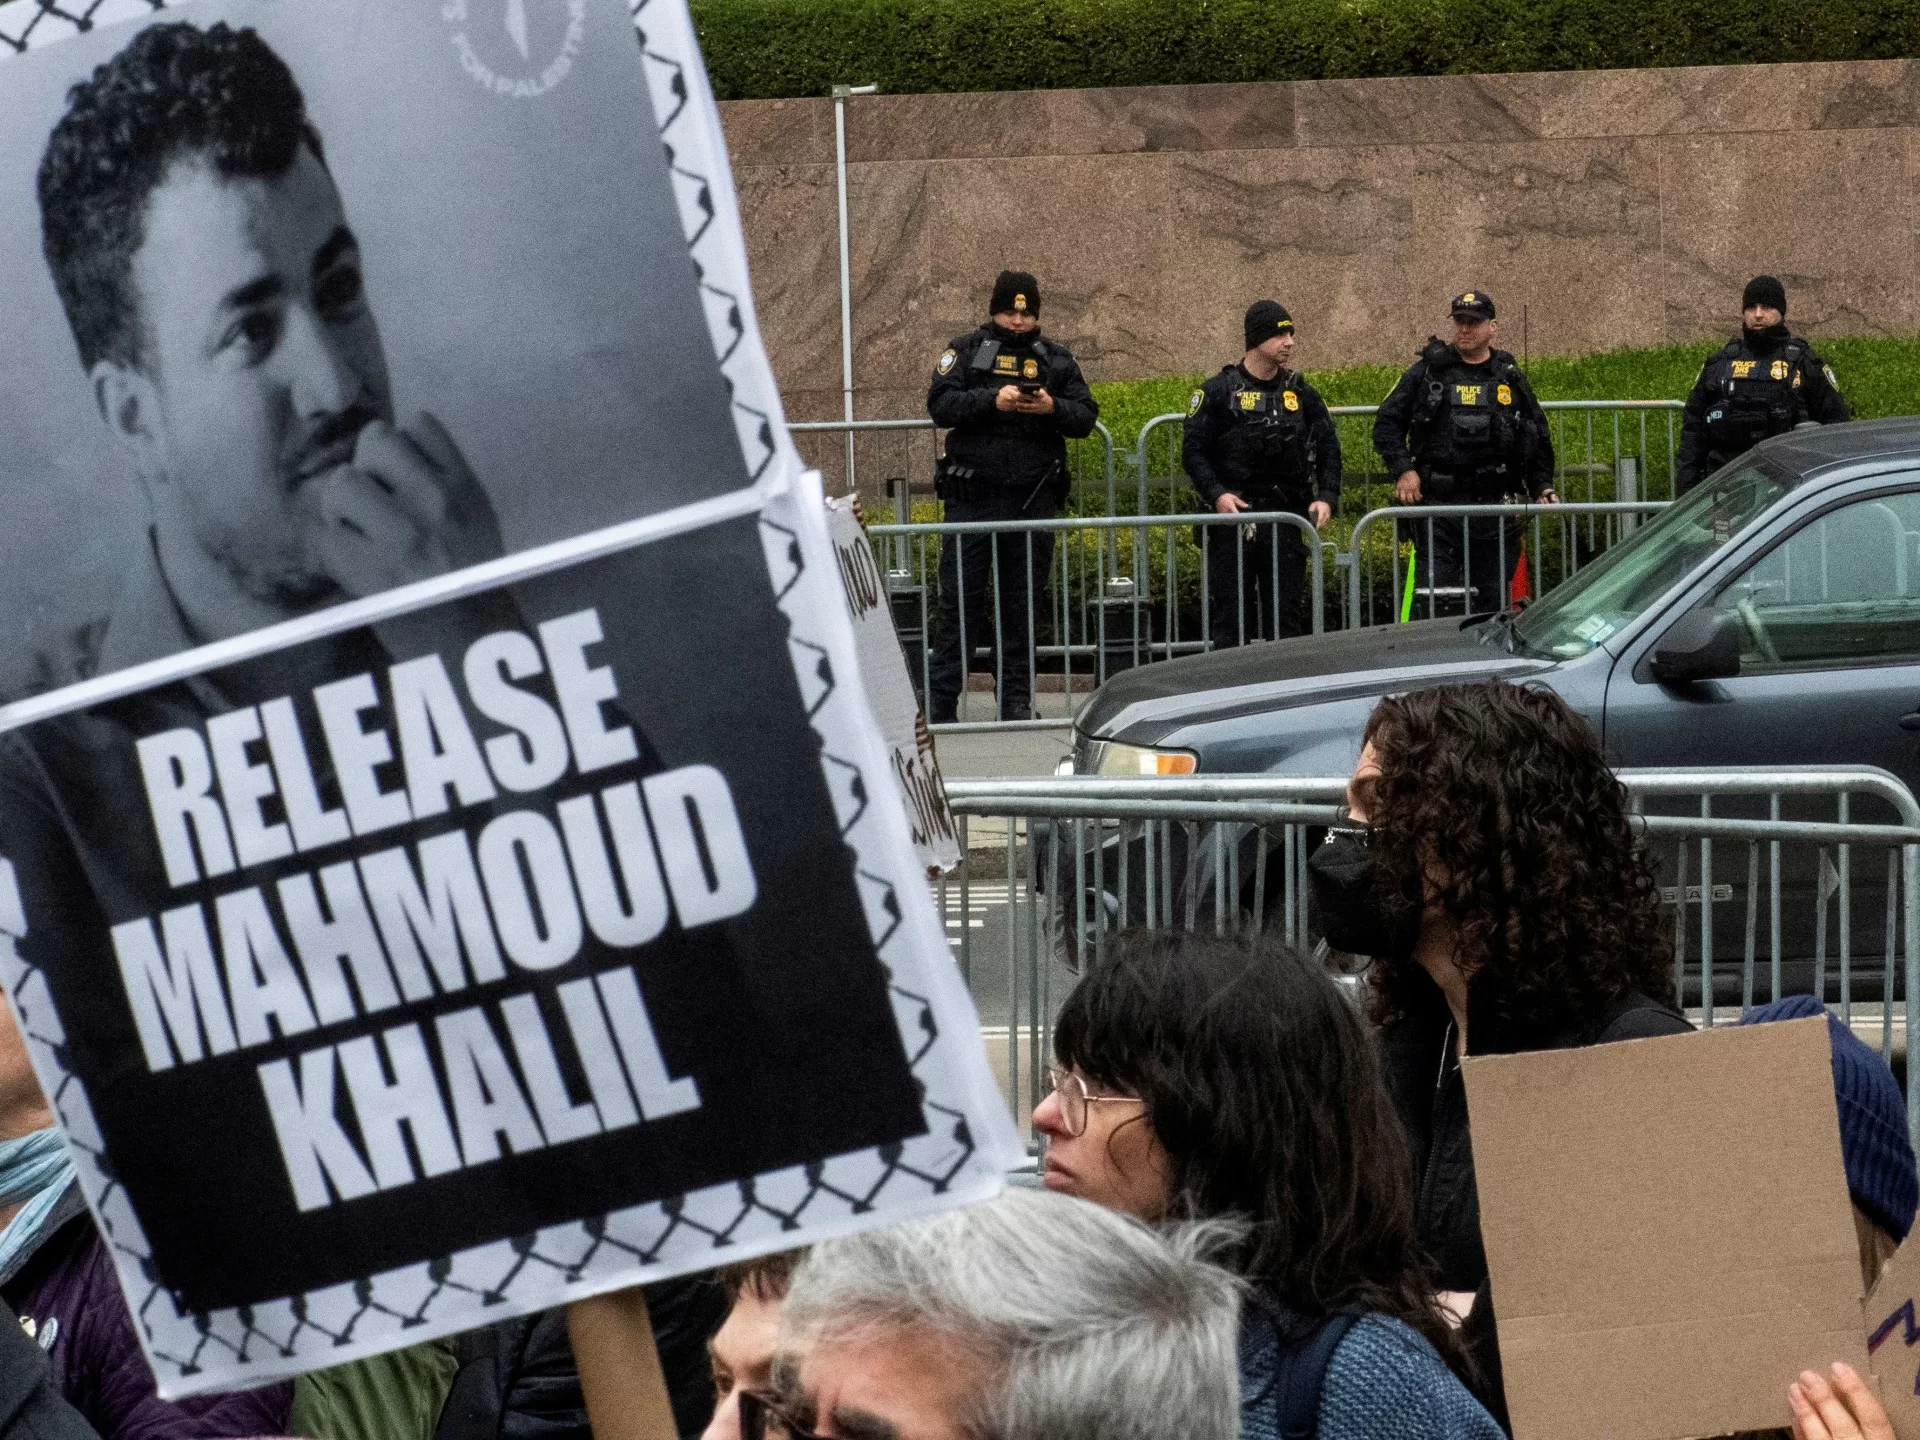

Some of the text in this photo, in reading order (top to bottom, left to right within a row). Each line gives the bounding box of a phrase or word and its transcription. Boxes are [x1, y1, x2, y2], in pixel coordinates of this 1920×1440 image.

[1456, 385, 1482, 394] POLICE
[1461, 393, 1476, 401] DHS
[135, 608, 638, 888] RELEASE
[109, 764, 758, 1073] MAHMOUD
[257, 967, 702, 1213] KHALIL
